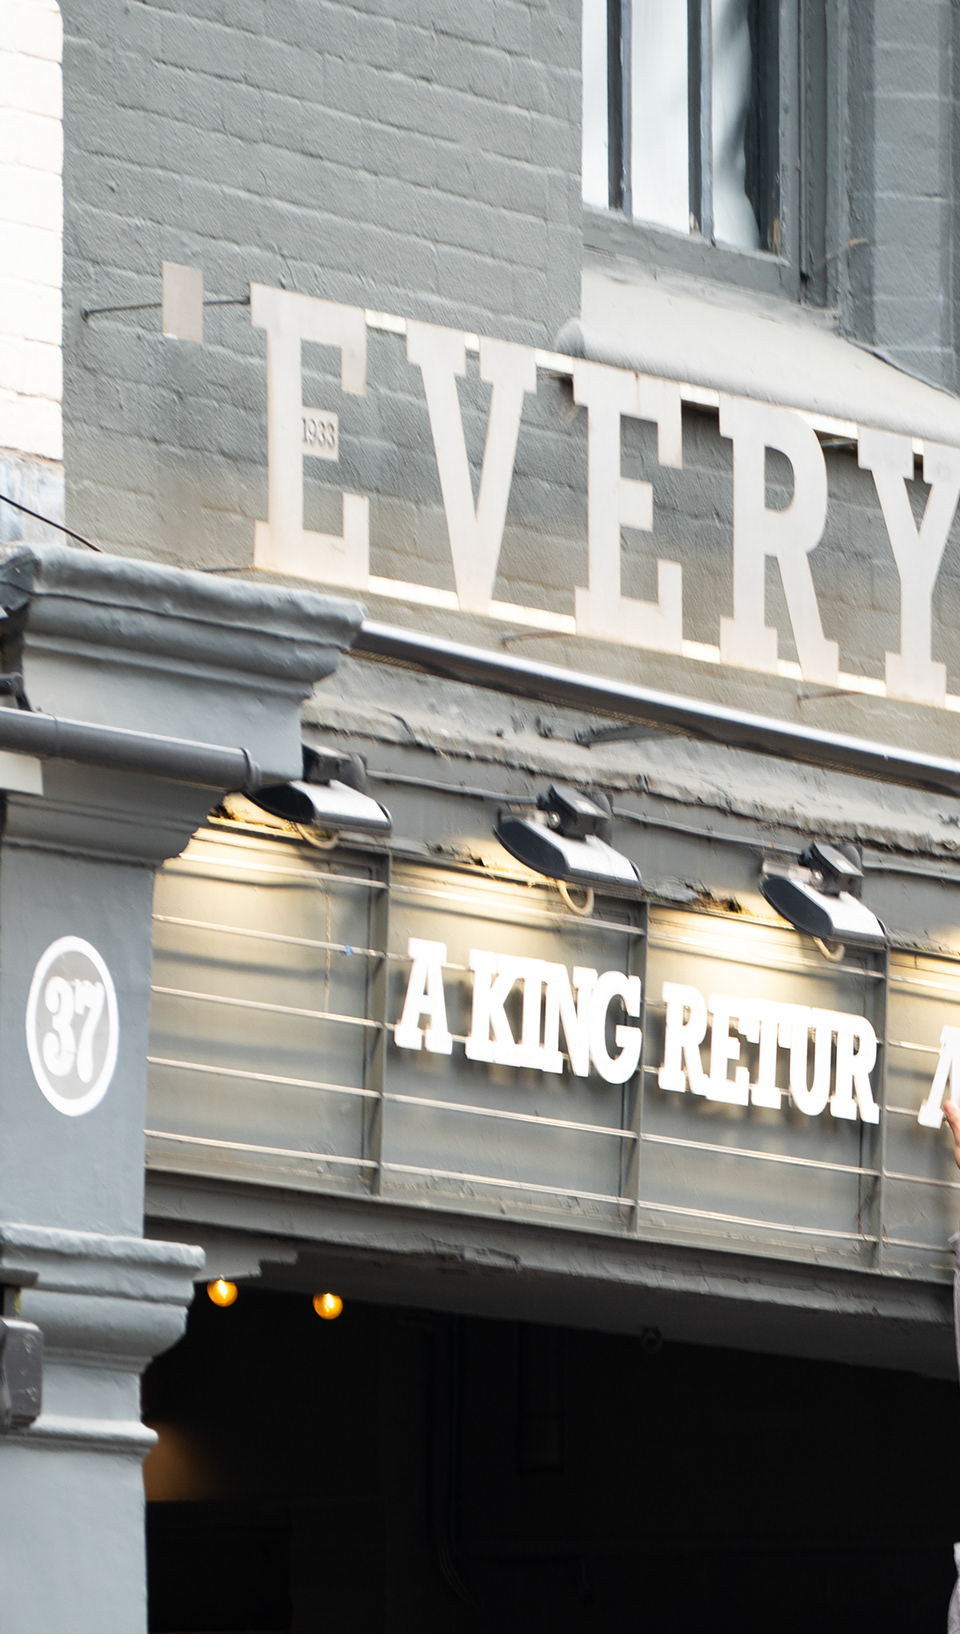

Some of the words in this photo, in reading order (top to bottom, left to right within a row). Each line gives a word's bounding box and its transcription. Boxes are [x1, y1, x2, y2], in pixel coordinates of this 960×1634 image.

[301, 416, 336, 450] 1933
[42, 975, 106, 1084] 37
[394, 937, 453, 1056] A
[465, 948, 643, 1085] KING
[658, 981, 881, 1125] RETUR
